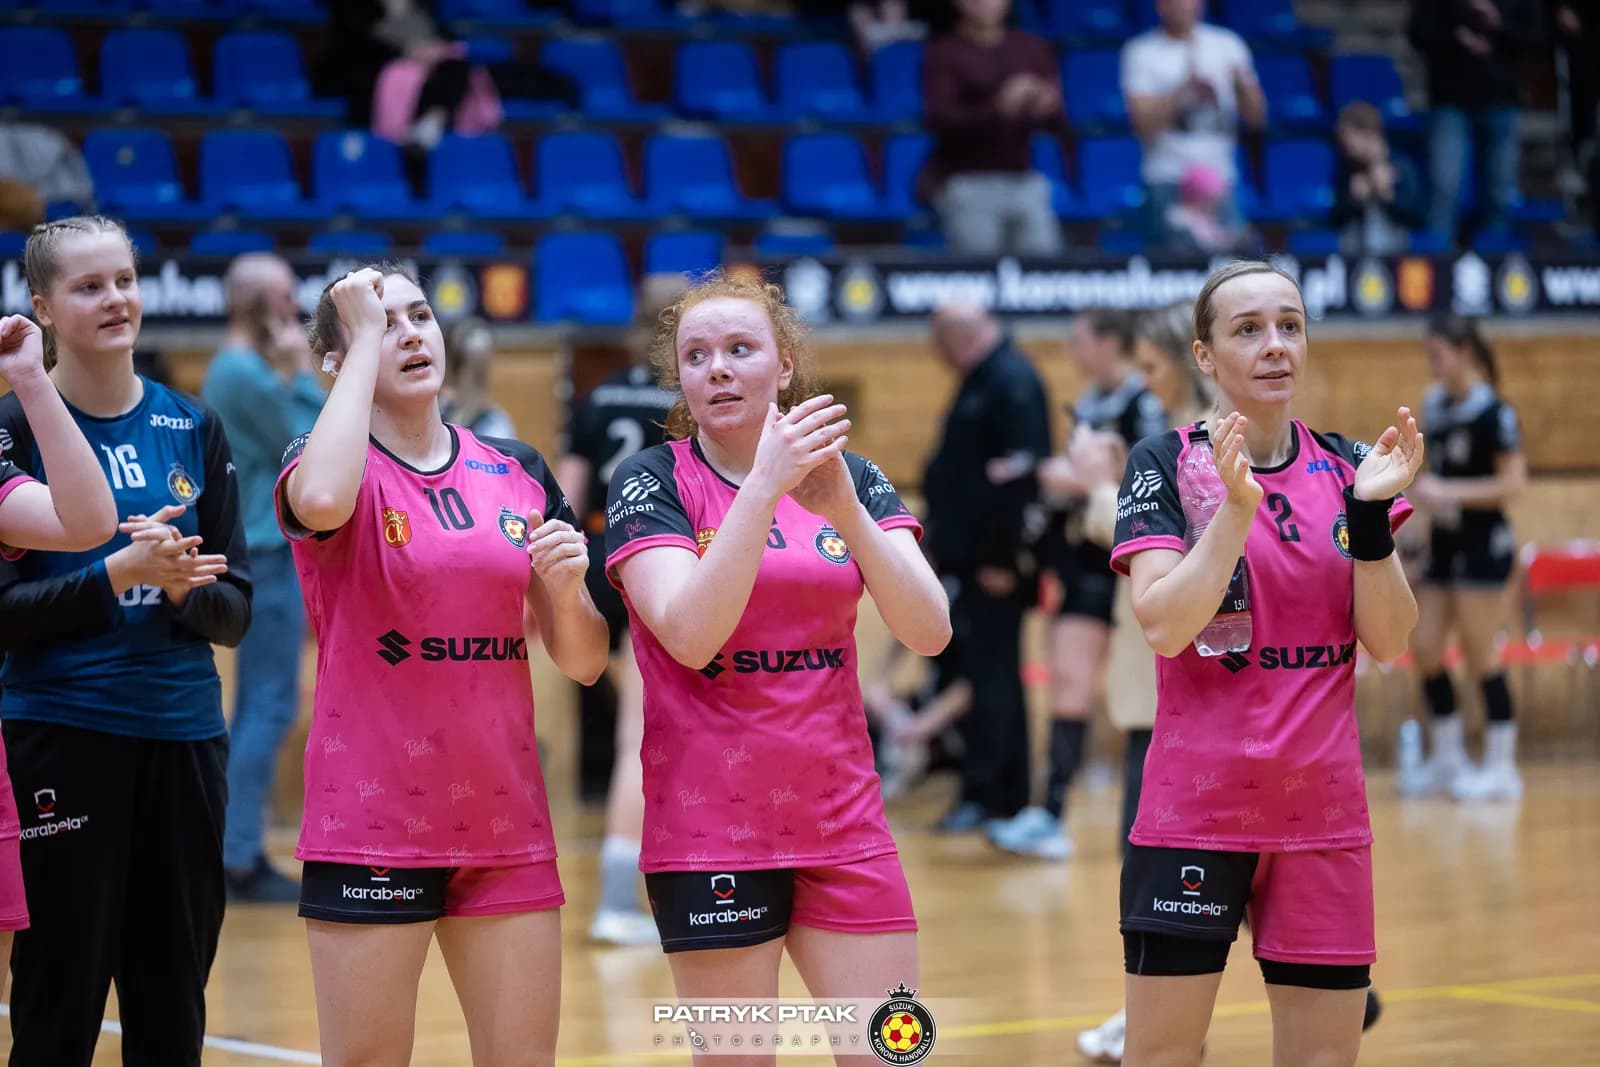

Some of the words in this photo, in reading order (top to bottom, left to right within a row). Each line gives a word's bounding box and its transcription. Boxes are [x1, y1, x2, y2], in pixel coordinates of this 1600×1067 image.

[101, 443, 146, 489] 16
[464, 459, 510, 474] oma
[424, 488, 475, 531] 10
[608, 500, 622, 518] Sun
[1117, 502, 1159, 521] Horizon
[1118, 495, 1132, 509] Sun
[609, 503, 655, 528] Horizon
[1267, 493, 1301, 542] 2
[386, 523, 407, 543] CK
[343, 884, 415, 901] karabela
[1153, 897, 1221, 916] karabela
[689, 907, 761, 926] karabela
